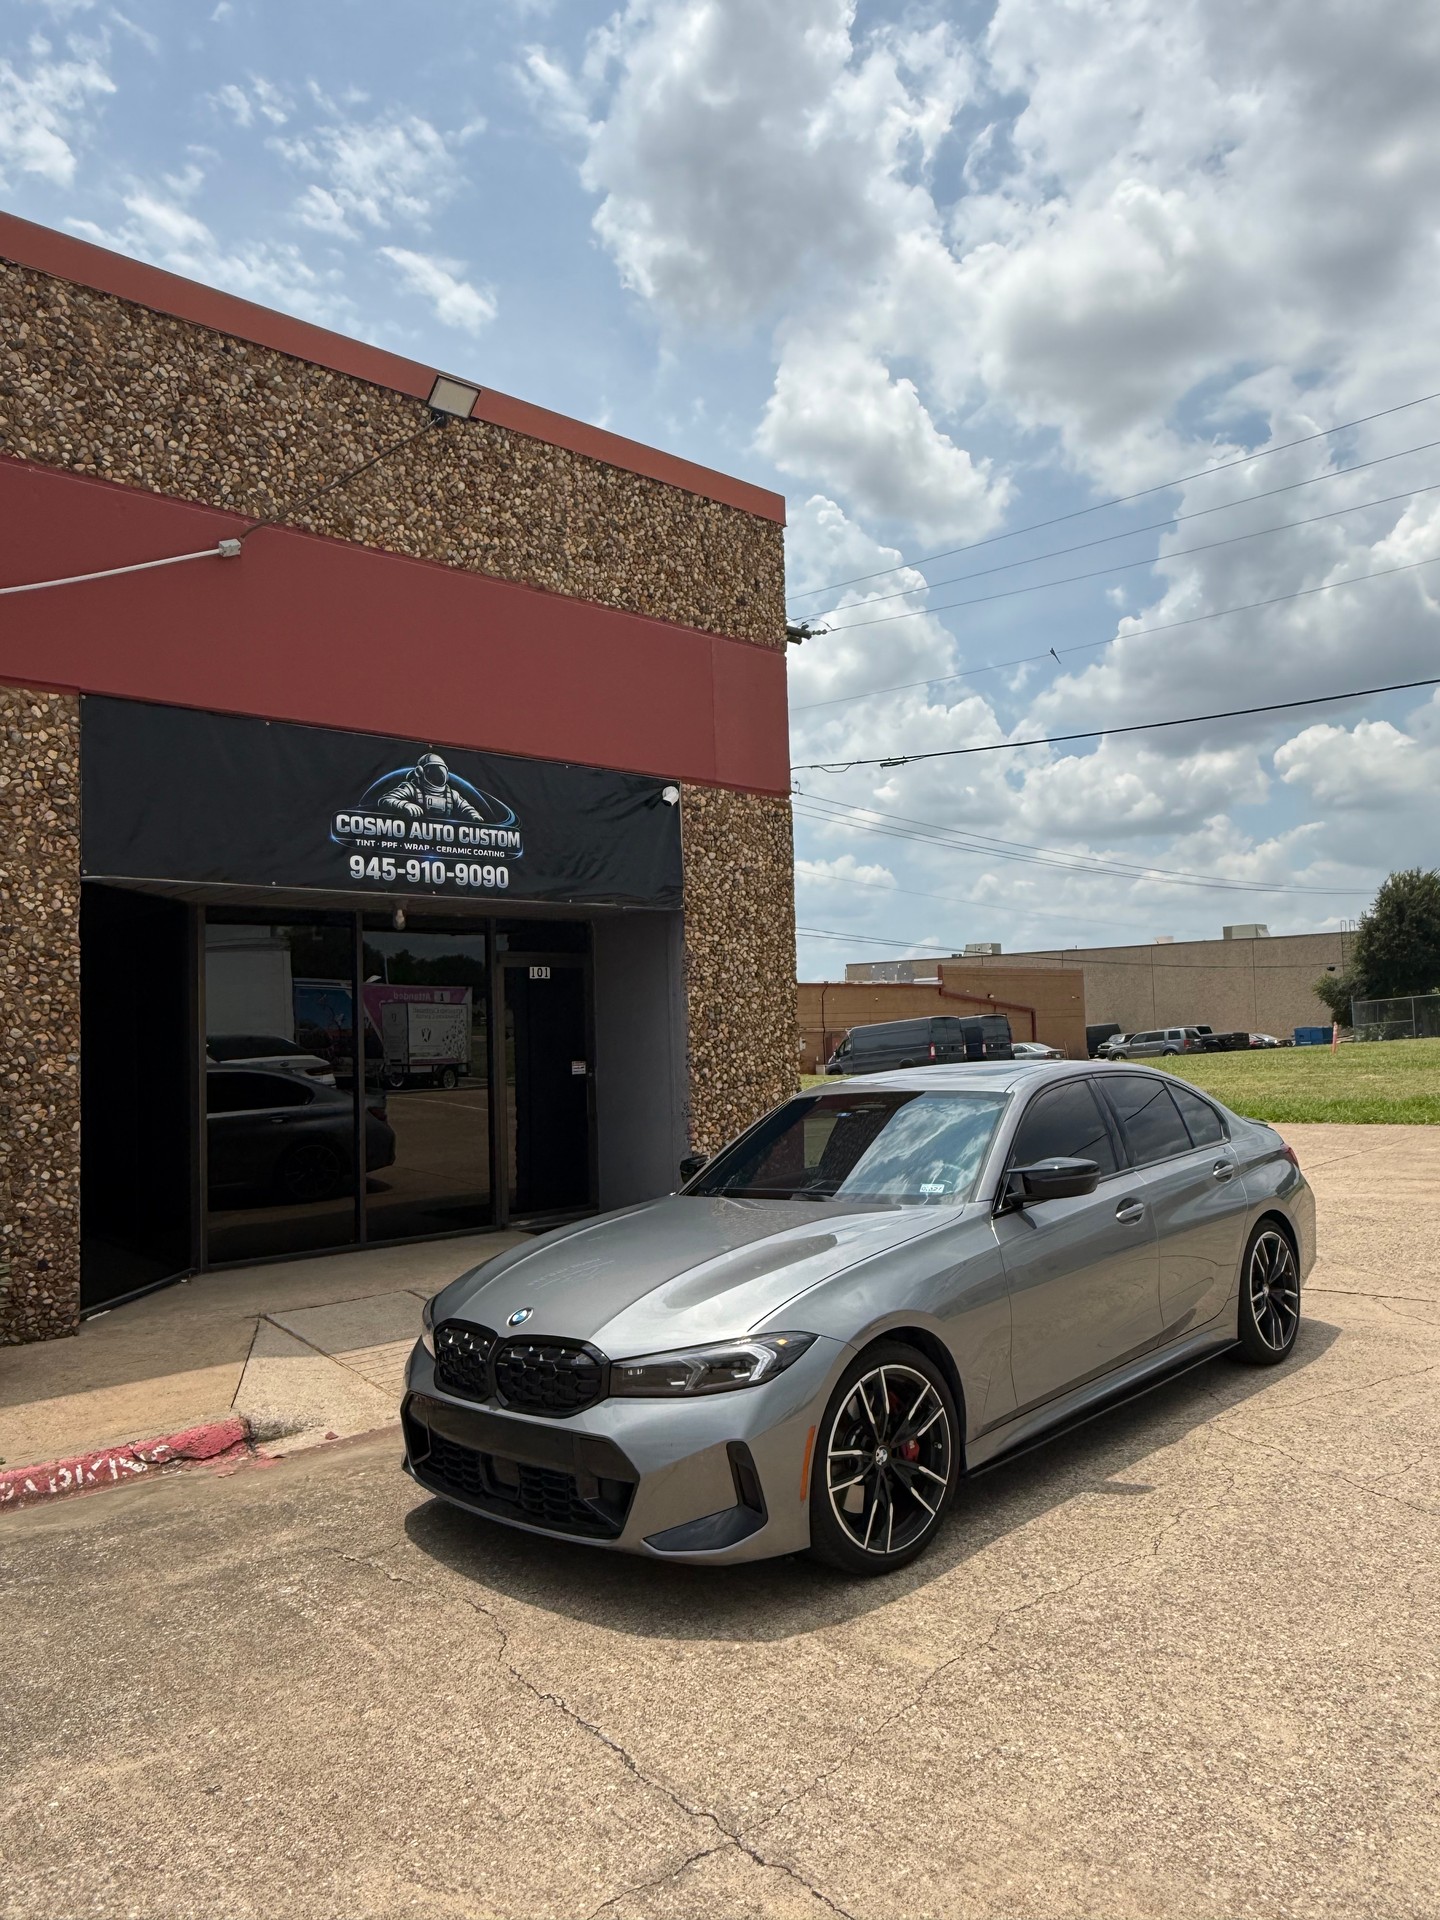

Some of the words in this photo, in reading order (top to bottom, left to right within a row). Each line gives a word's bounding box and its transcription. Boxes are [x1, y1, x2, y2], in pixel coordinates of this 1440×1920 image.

[336, 814, 405, 838] COSMO
[409, 821, 455, 842] AUTO
[458, 826, 520, 848] CUSTOM
[355, 838, 376, 848] TINT
[381, 841, 398, 849] PPF
[404, 842, 430, 851] WRAP
[436, 845, 472, 855] CERAMIC
[473, 848, 505, 858] COATING
[349, 855, 509, 889] 945-910-9090
[531, 967, 549, 978] 101
